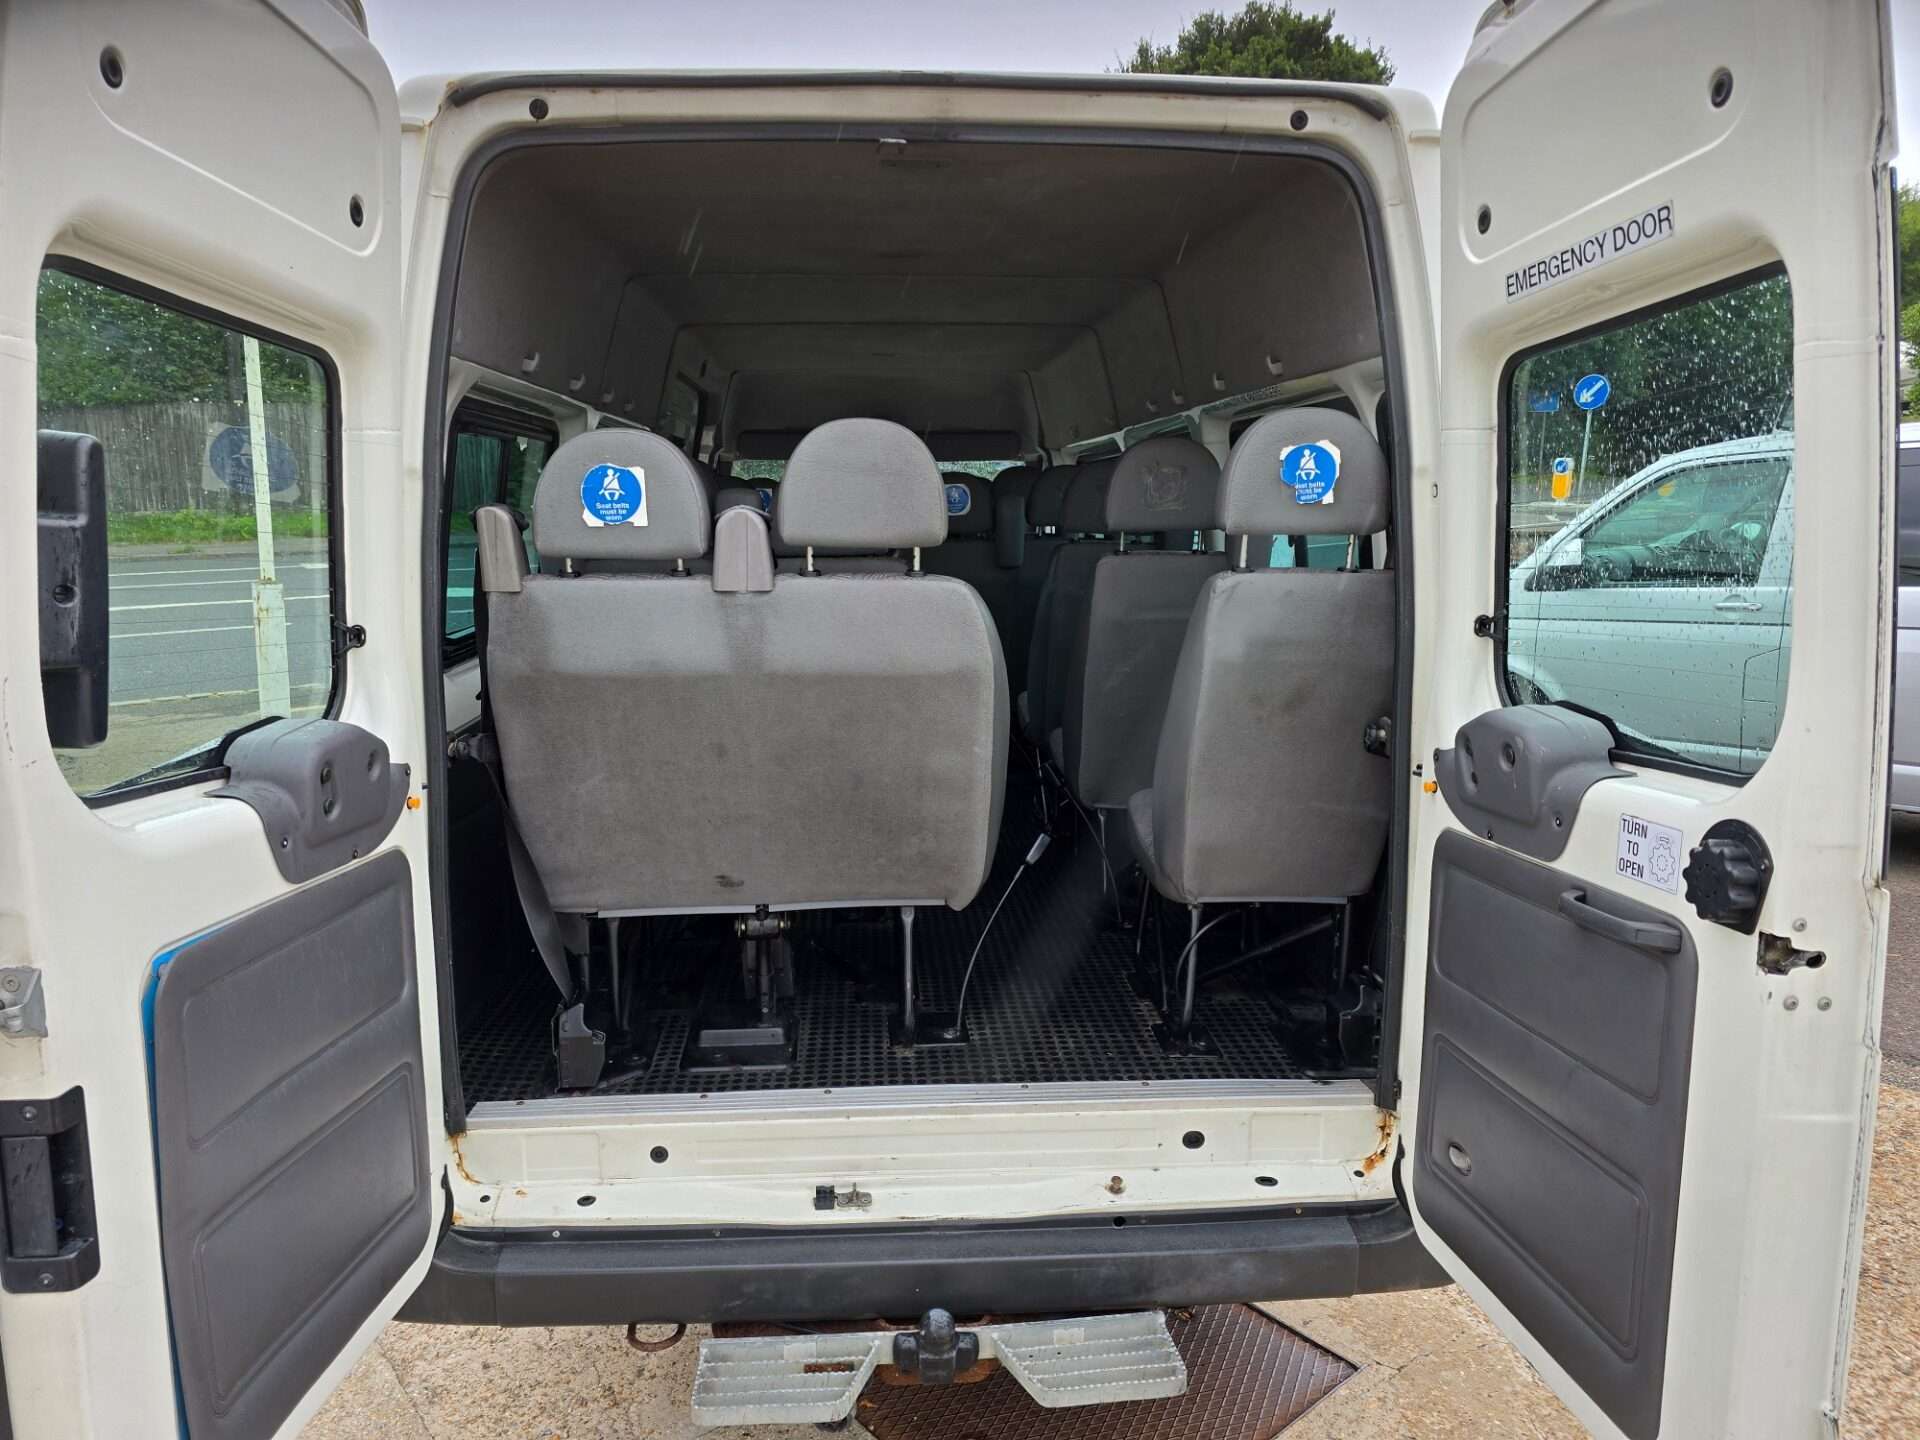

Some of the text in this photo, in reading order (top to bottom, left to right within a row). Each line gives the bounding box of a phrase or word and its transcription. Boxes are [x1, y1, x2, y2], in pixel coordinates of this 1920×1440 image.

[1506, 205, 1673, 297] EMERGENCY DOOR
[1622, 818, 1648, 839] TURN
[1627, 840, 1639, 856] TO
[1619, 857, 1644, 879] OPEN
